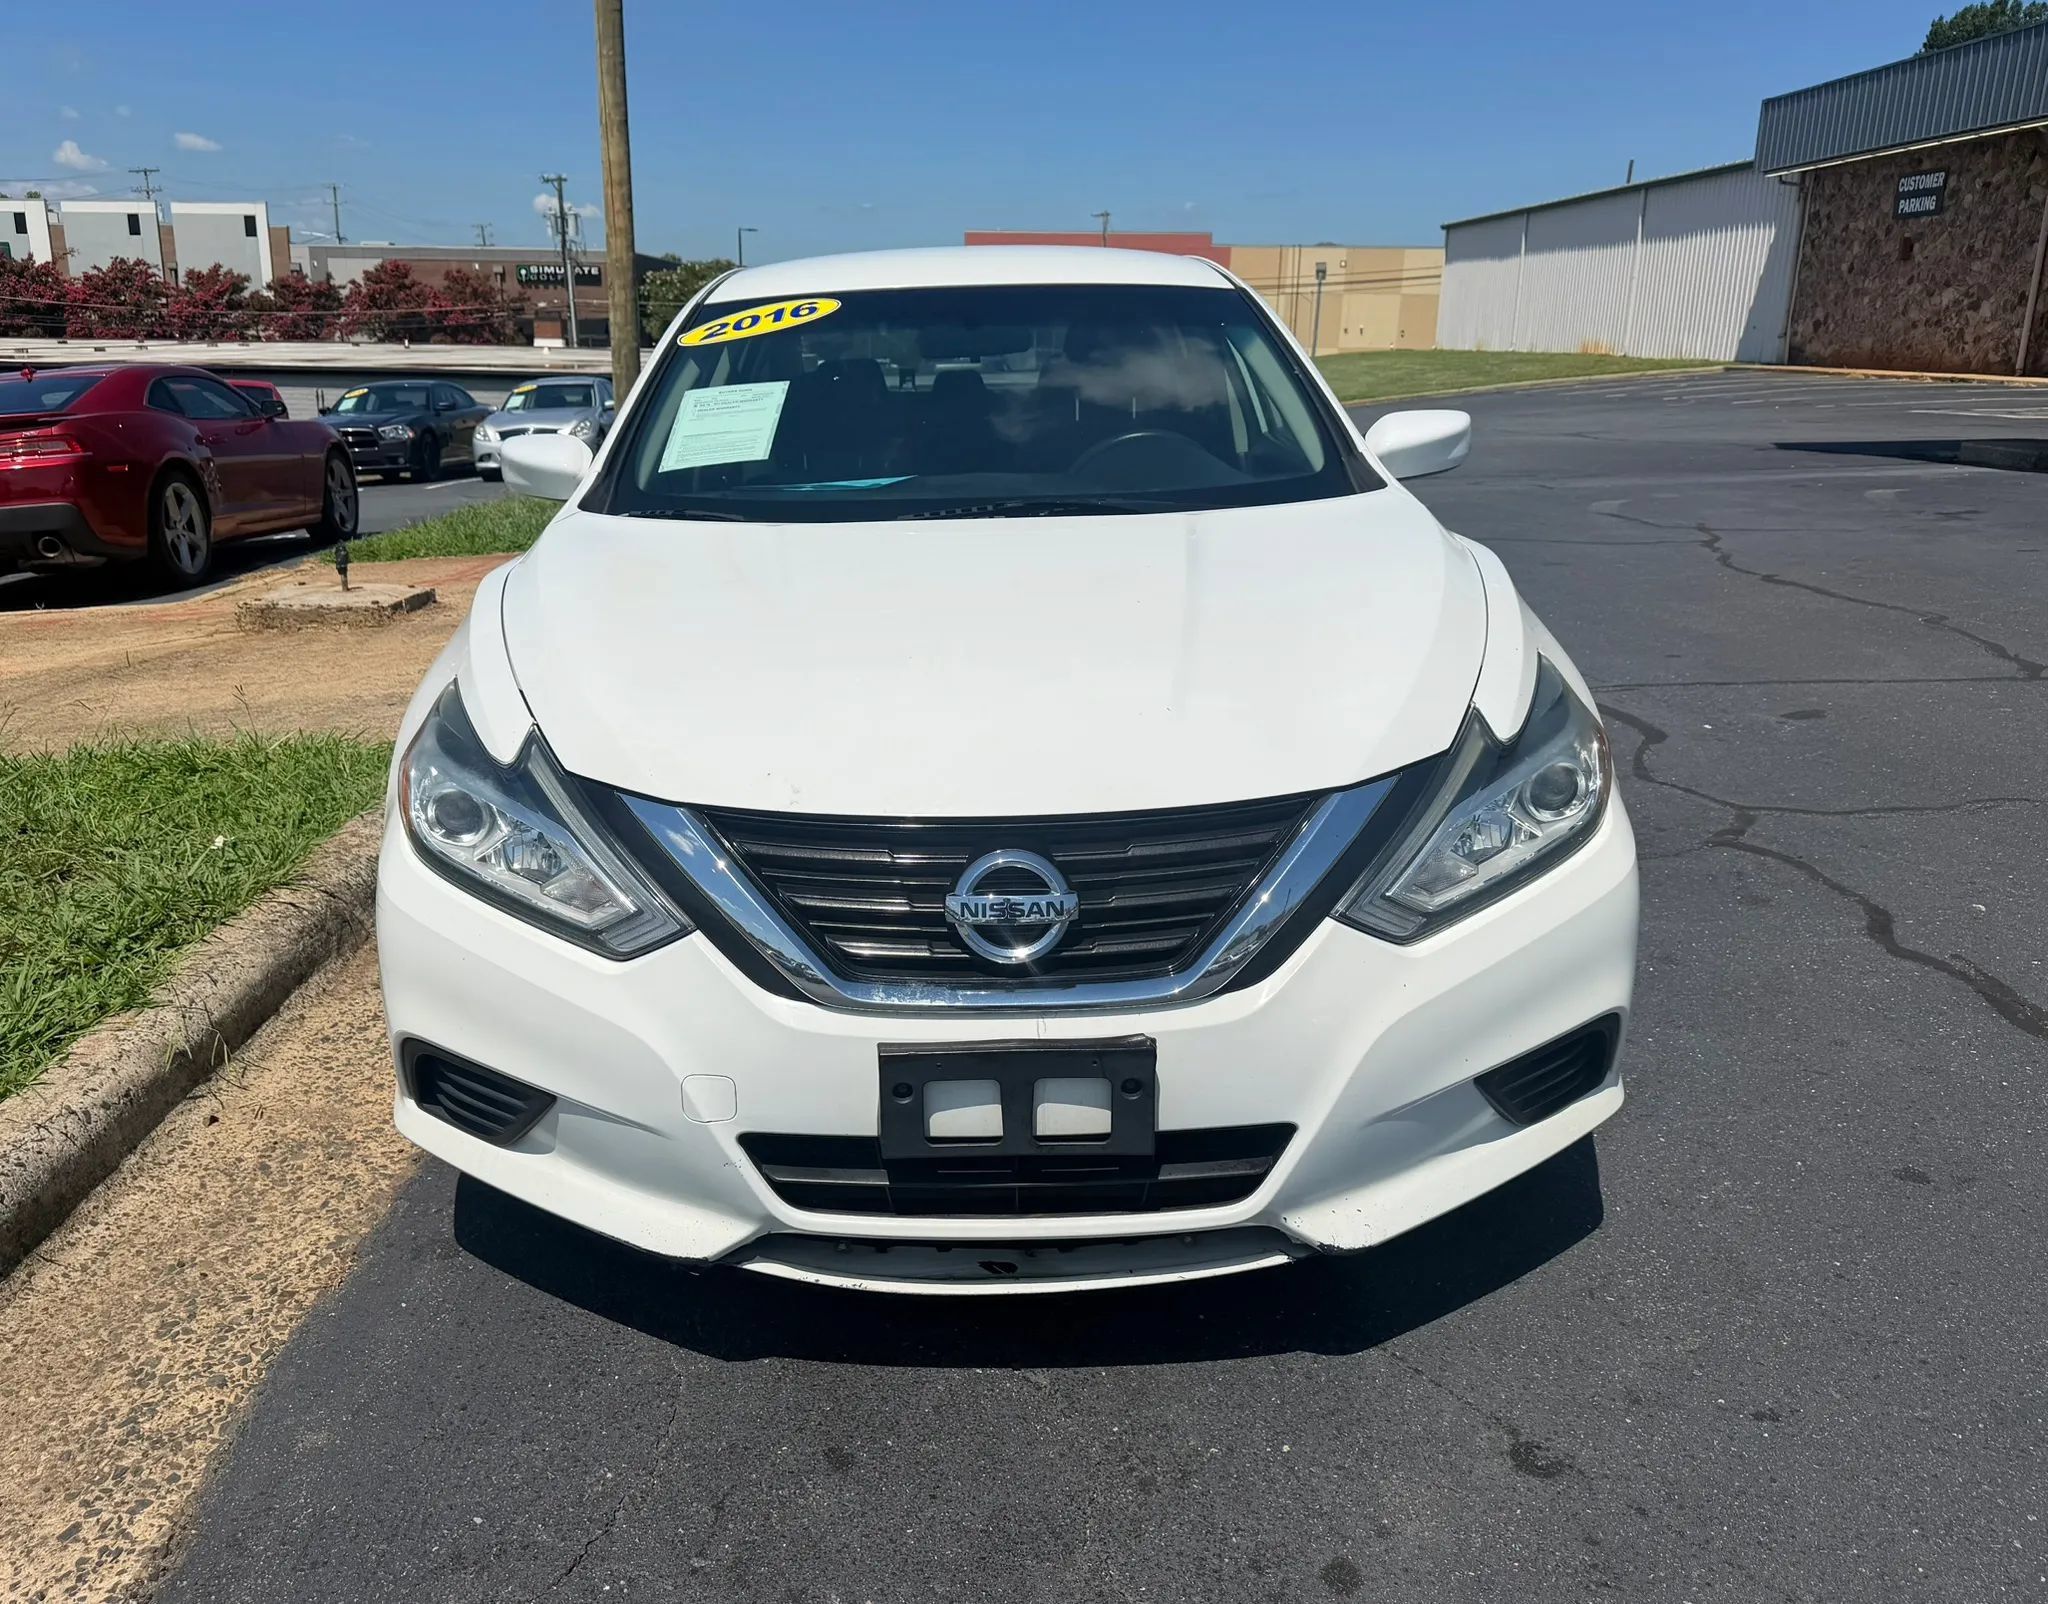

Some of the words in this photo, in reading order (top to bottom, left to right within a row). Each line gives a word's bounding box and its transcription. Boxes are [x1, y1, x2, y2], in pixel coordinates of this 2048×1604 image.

[1898, 171, 1946, 192] CUSTOMER
[1898, 195, 1937, 214] PARKING
[530, 265, 599, 275] SIMUATE
[698, 301, 821, 342] 2016
[960, 900, 1065, 919] NISSAN
